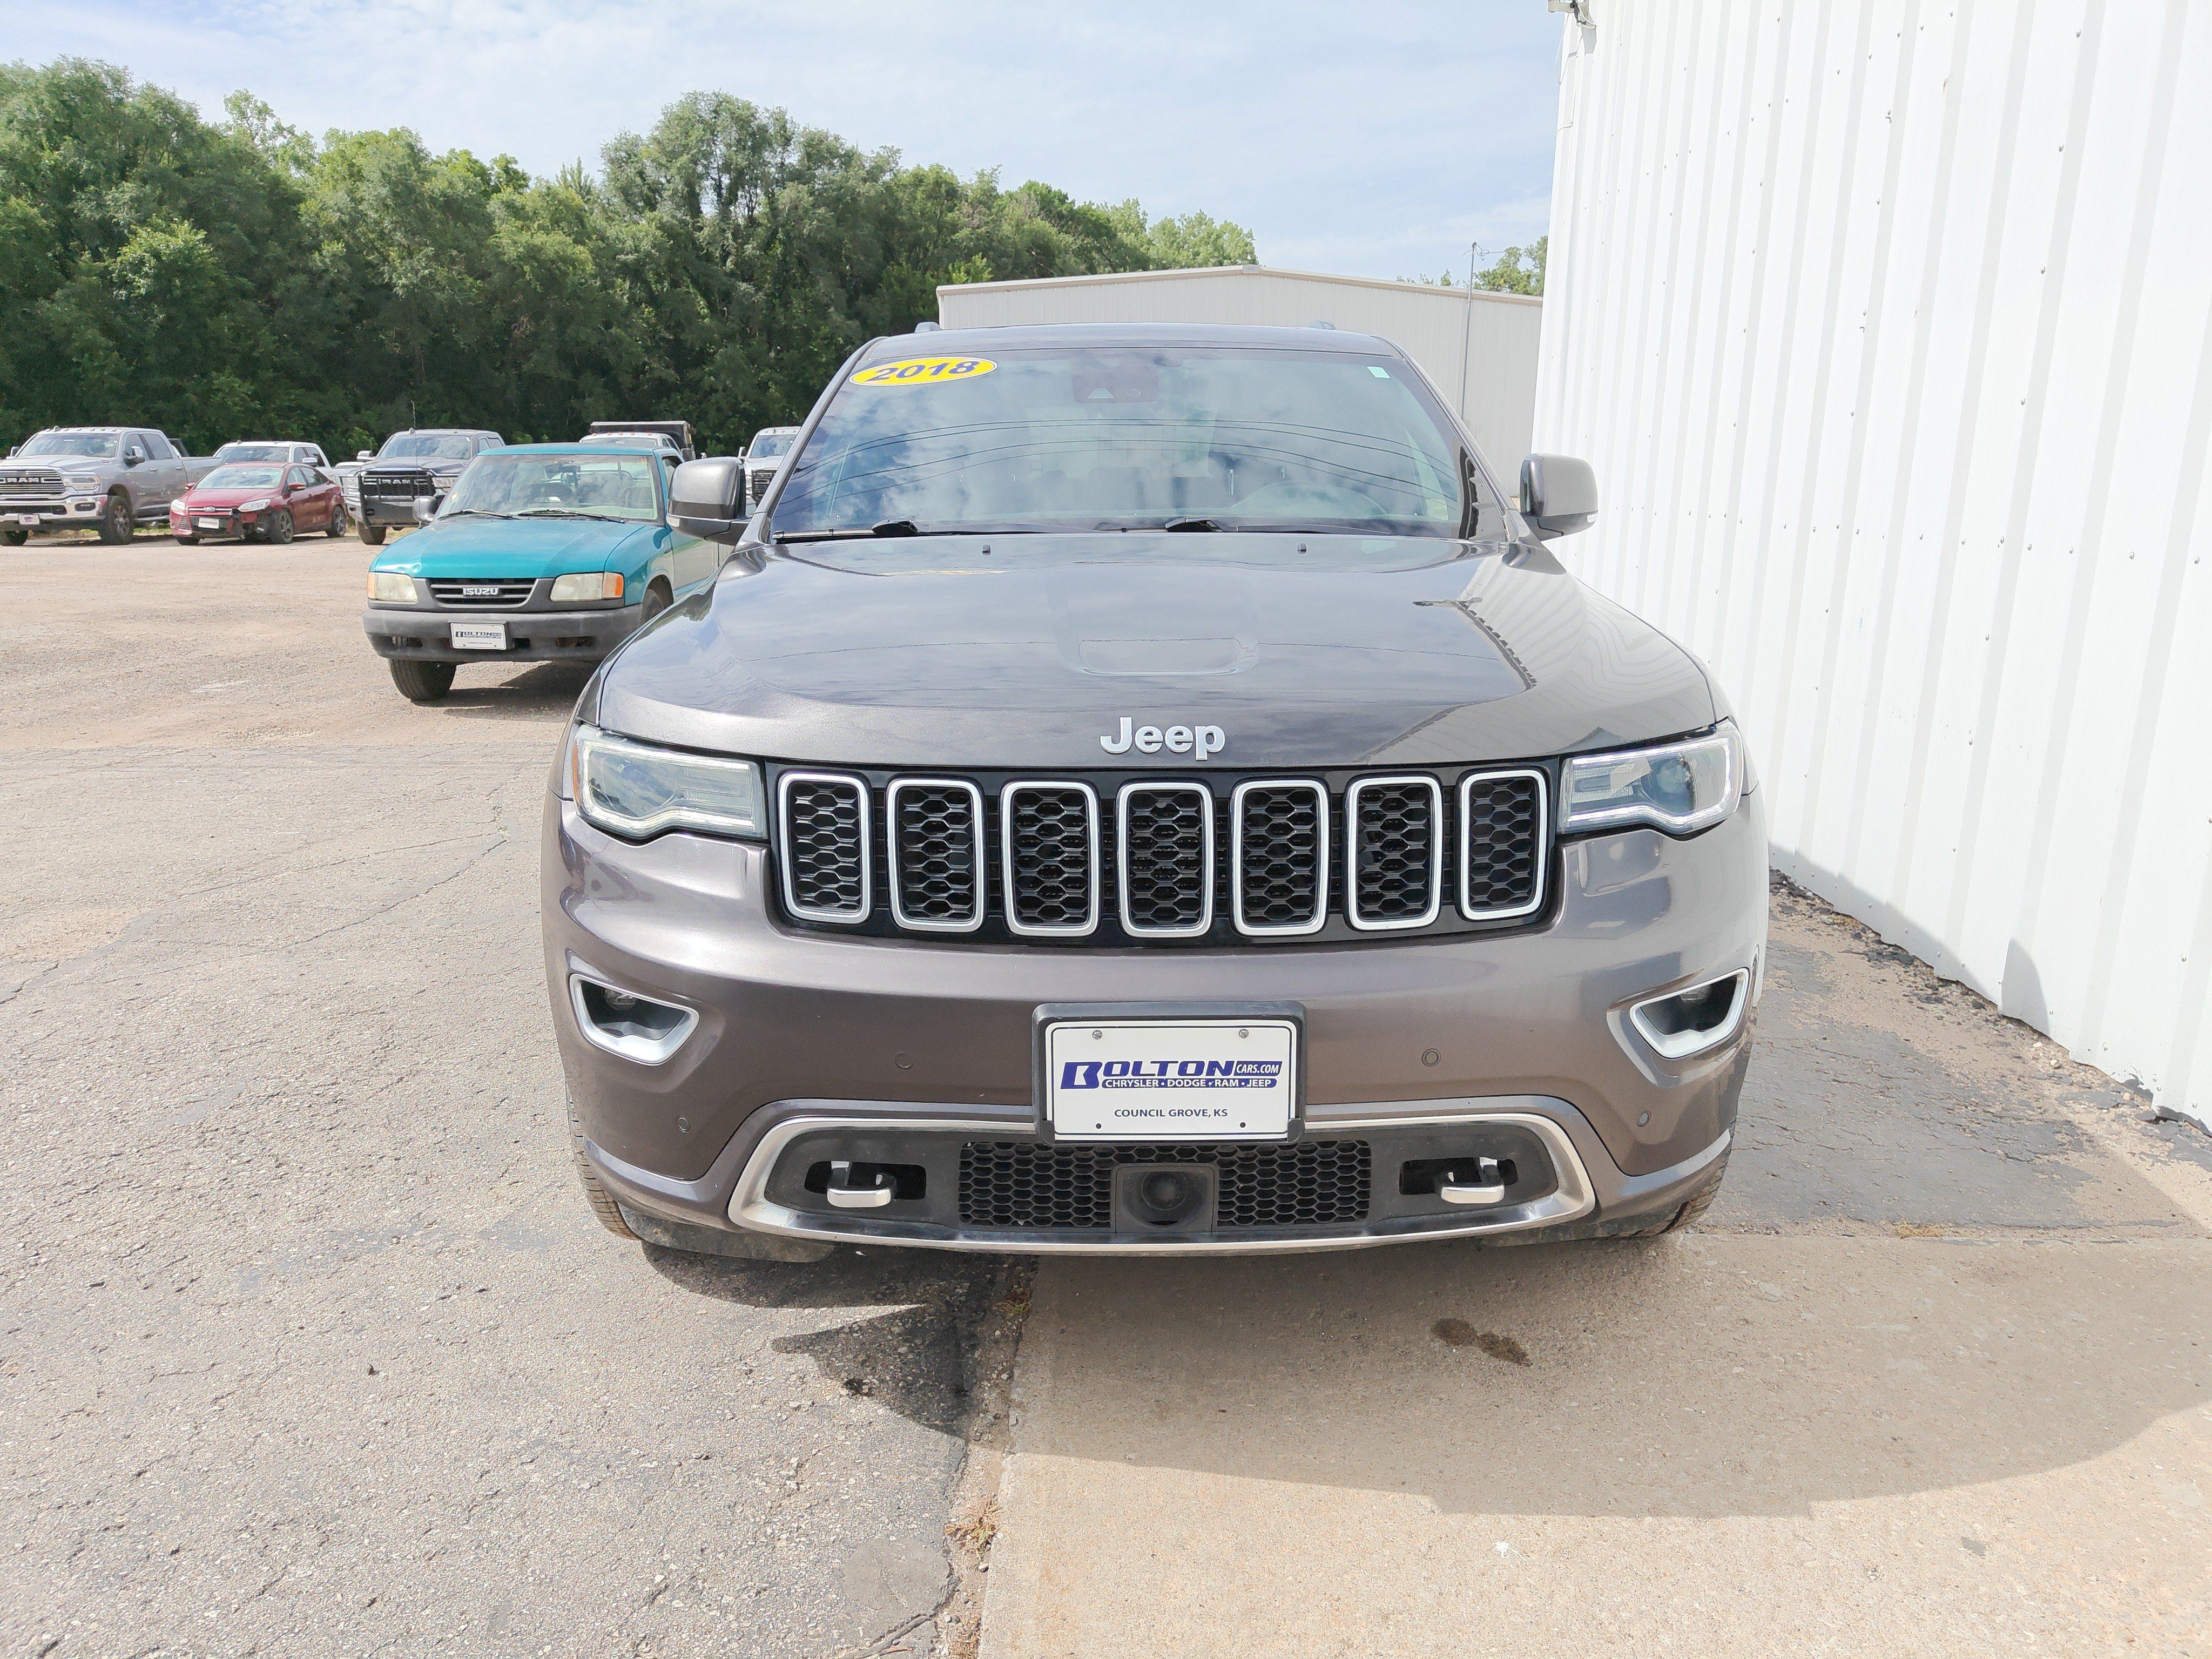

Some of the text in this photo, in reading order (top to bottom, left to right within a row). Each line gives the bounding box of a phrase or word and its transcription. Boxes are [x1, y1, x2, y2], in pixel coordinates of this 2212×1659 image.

[864, 361, 980, 382] 2018
[462, 587, 498, 596] ISUZU
[1100, 716, 1225, 761] Jeep
[1060, 1061, 1279, 1089] BOLTON CARS.COM
[1105, 1078, 1271, 1088] CHRYSLER DODGE RAM JEEP
[1114, 1109, 1228, 1118] COUNCIL GROVE, KS
